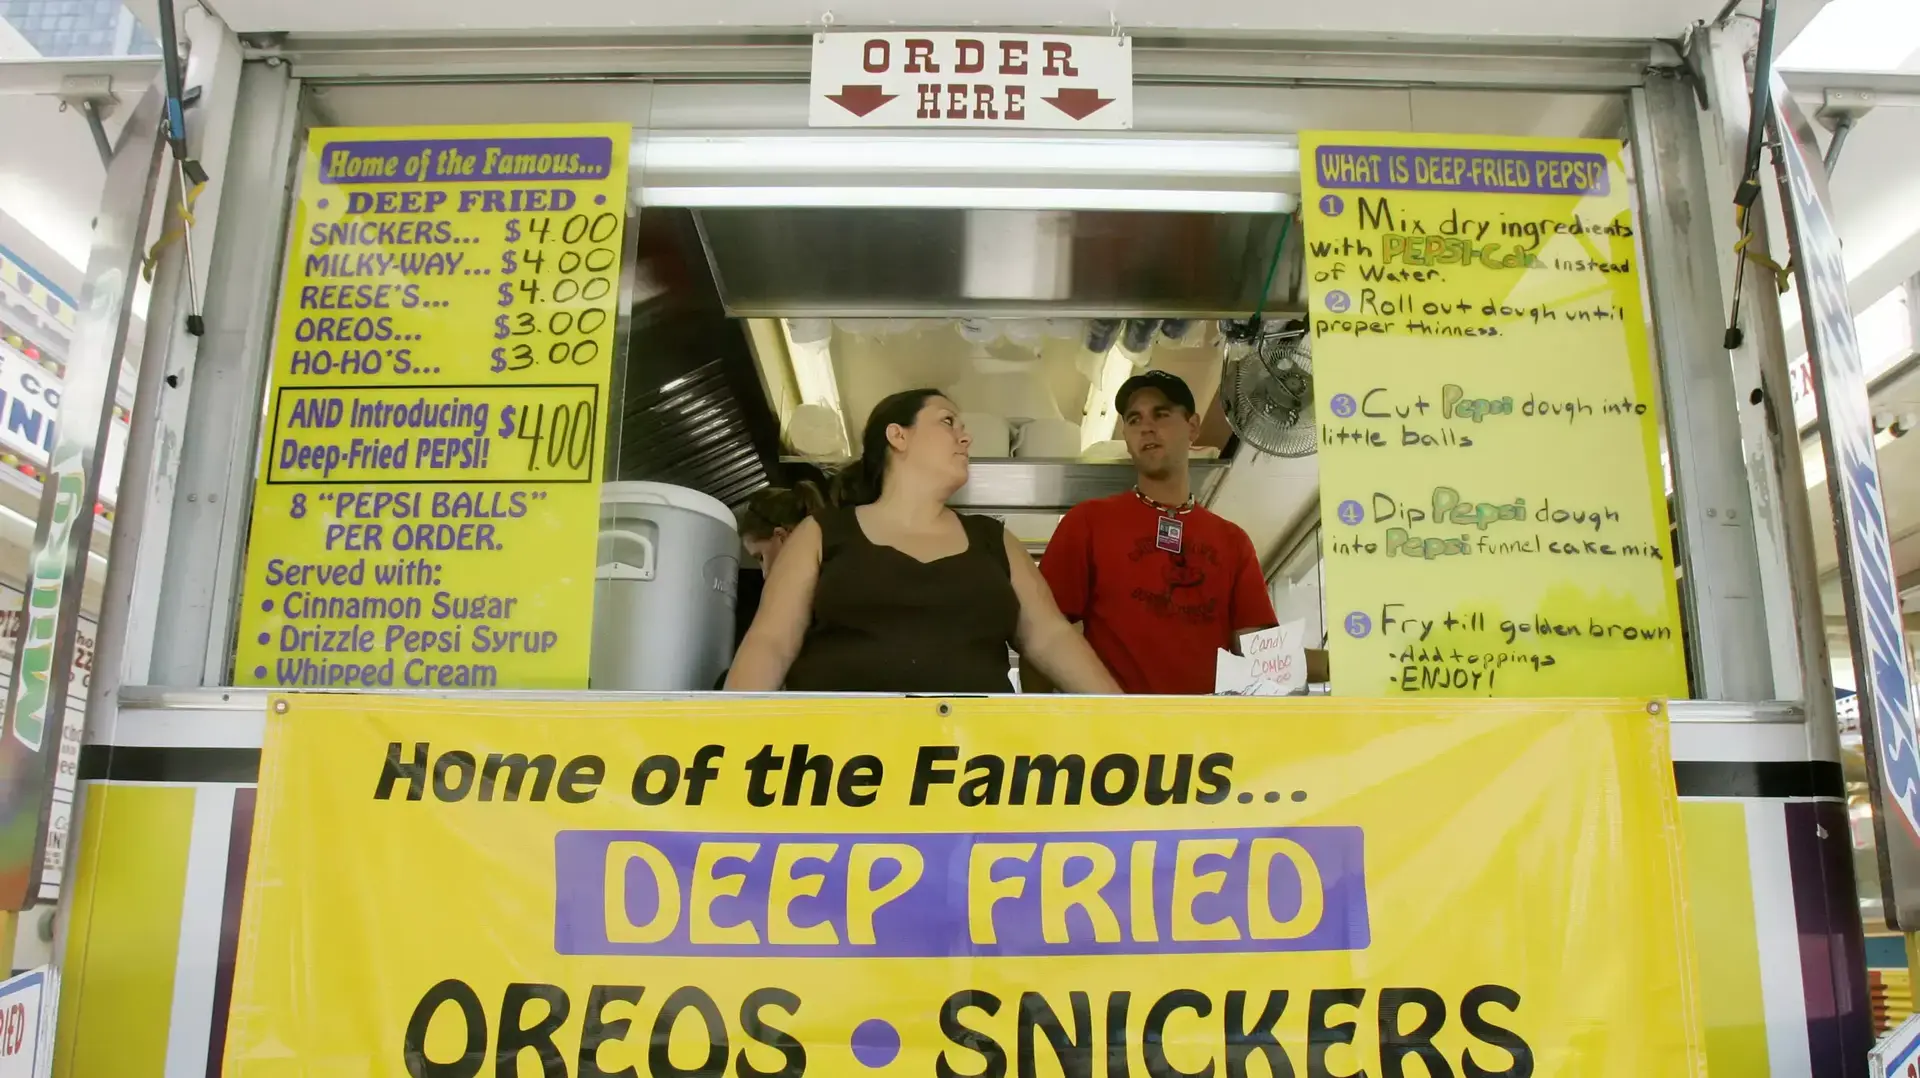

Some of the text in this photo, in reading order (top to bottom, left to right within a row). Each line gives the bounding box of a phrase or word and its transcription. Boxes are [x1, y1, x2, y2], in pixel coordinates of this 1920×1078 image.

[862, 39, 1079, 77] ORDER
[916, 83, 1025, 121] HERE
[327, 147, 602, 181] Home of the Famous...
[1321, 153, 1605, 192] WHAT IS DEEP-FRIED PEPSI?
[346, 188, 577, 215] DEEP FRIED
[309, 212, 618, 246] SNICKERS... $4.00
[1358, 197, 1426, 235] Mix
[1439, 208, 1490, 241] dry
[1500, 212, 1633, 250] ingredients
[304, 247, 616, 277] MILKY-WAY... $4.00
[1310, 237, 1373, 257] with
[1555, 256, 1630, 274] instead
[1314, 262, 1447, 283] of Water.
[300, 276, 611, 310] REESE'S... $4.00
[1360, 288, 1413, 317] Roll
[1423, 302, 1473, 315] out
[1481, 298, 1556, 321] dough
[1566, 306, 1624, 322] until
[295, 307, 606, 342] OREOS... $3.00
[1316, 319, 1503, 339] proper thinness.
[290, 339, 598, 376] HO-HO'S... $3.00
[1362, 388, 1430, 419] Cut
[1521, 392, 1593, 425] dough
[1602, 394, 1648, 416] into
[288, 398, 591, 471] AND Introducing $4.00
[1322, 424, 1473, 448] little balls
[279, 437, 490, 478] Deep-Fried PEPSI!
[289, 491, 548, 519] 8 “PEPSI BALLS”
[1372, 492, 1425, 528] Dip
[1431, 486, 1527, 530] Pepsi
[1535, 498, 1620, 531] dough
[325, 524, 504, 551] PER ORDER.
[1332, 527, 1664, 561] into Pepsi funnel cake mix
[265, 558, 442, 586] Served with:
[283, 591, 518, 620] Cinnamon Sugar
[279, 624, 558, 654] Drizzle Pepsi Syrup
[1381, 604, 1434, 642] Fry
[1443, 611, 1485, 632] till
[1500, 613, 1581, 644] golden
[1588, 617, 1672, 641] brown
[276, 657, 497, 687] Whipped Cream
[1450, 649, 1556, 668] toppings
[373, 741, 1309, 807] Home of the Famous...
[604, 836, 1325, 947] DEEP FRIED
[402, 977, 1535, 1078] OREOS SNICKERS
